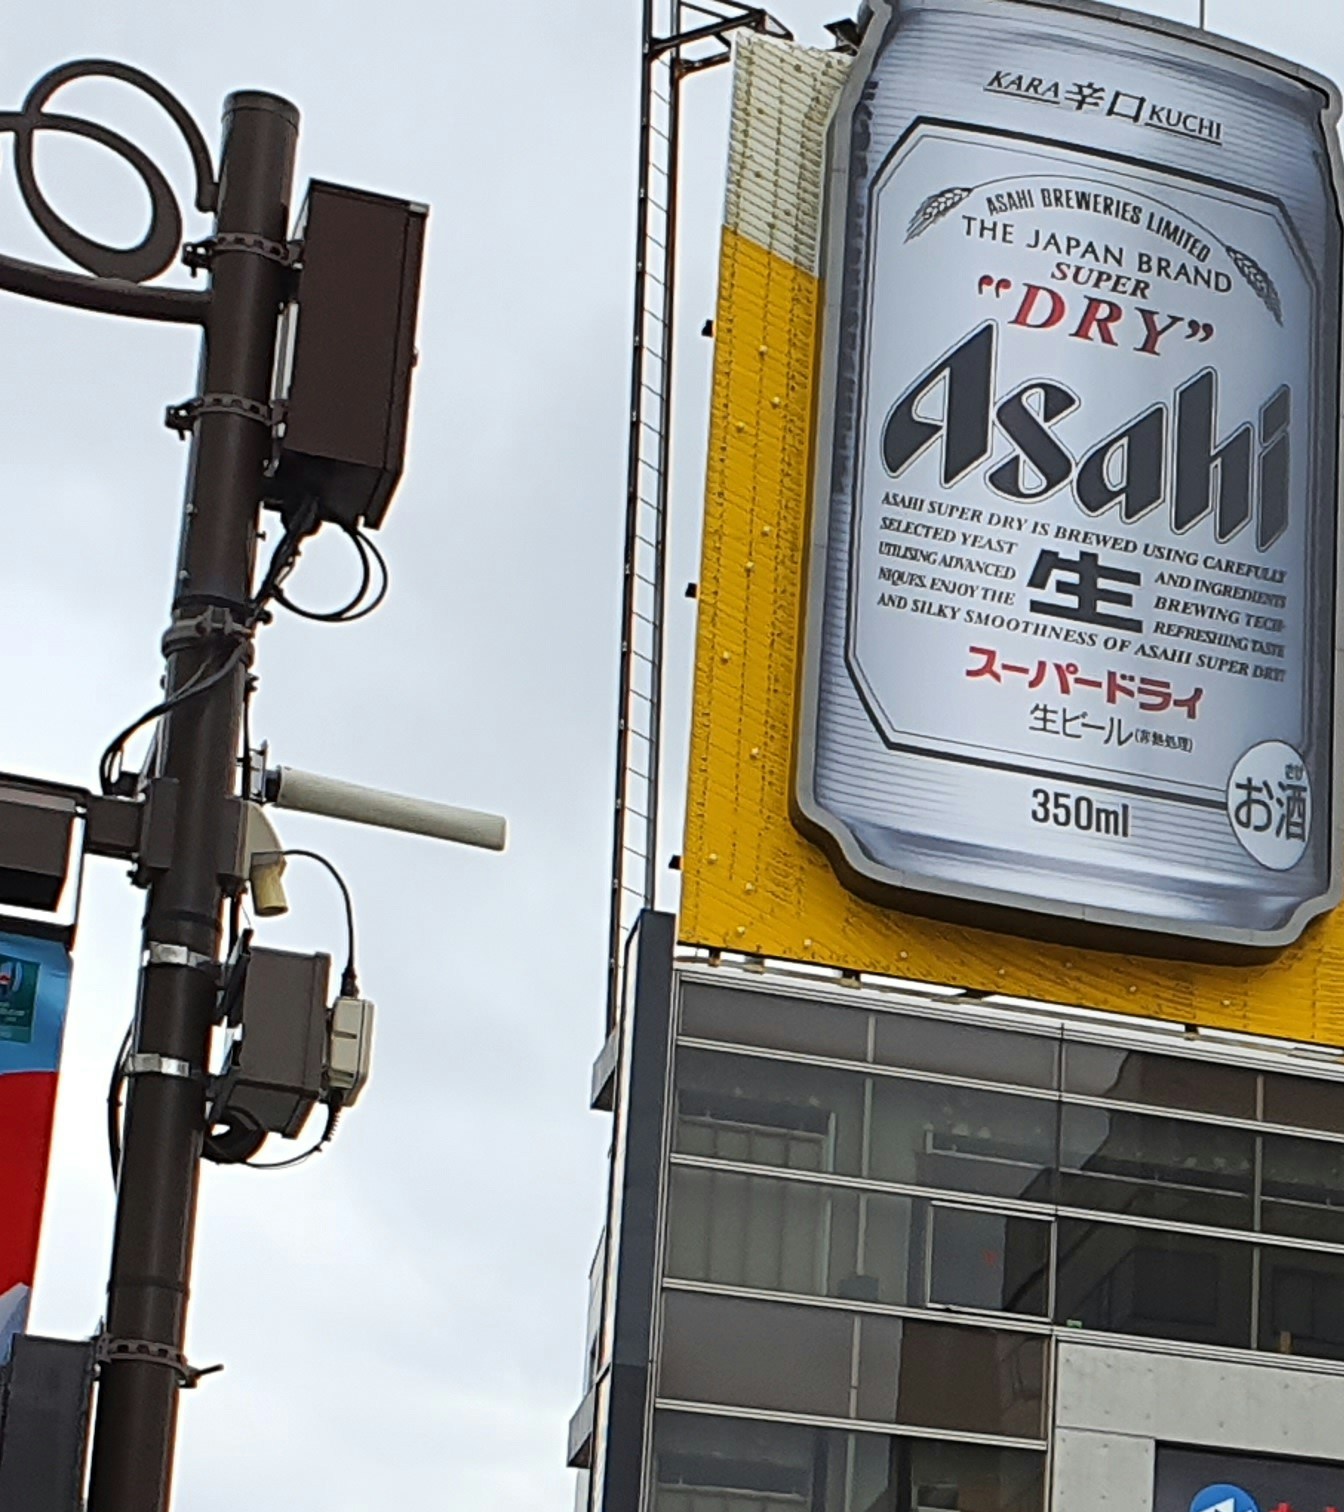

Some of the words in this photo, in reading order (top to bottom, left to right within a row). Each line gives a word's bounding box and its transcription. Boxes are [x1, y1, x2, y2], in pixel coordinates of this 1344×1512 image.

[987, 69, 1061, 101] KARA
[1064, 80, 1146, 123] 辛口
[1149, 104, 1224, 140] KUCHI
[962, 215, 1015, 244] THE
[1026, 229, 1124, 267] JAPAN
[1137, 252, 1233, 294] BRAND
[986, 188, 1035, 216] ASAHI
[1040, 188, 1143, 225] BREWERIES
[1146, 211, 1212, 264] LIMITED
[1051, 262, 1151, 299] SUPER
[881, 319, 1291, 553] Asahi
[880, 516, 957, 543] SELECTED
[961, 532, 1019, 555] YEAST
[881, 491, 925, 512] ASAHI
[927, 500, 983, 524] SUPER
[988, 512, 1028, 532] DRY
[1031, 521, 1051, 536] IS
[1054, 525, 1138, 554] BREWED
[1142, 543, 1199, 566] USING
[1203, 555, 1289, 584] CAREFULLY
[929, 578, 979, 599] ENJOY
[980, 587, 1016, 606] THE
[938, 555, 1017, 581] ADVANCED
[1026, 548, 1143, 634] 生
[1154, 571, 1191, 589] AND
[1193, 579, 1288, 610] INGREDIENTS
[877, 592, 908, 610] AND
[911, 598, 961, 621] SILKY
[964, 609, 1098, 648] SMOOTHNESS
[1103, 636, 1132, 651] OF
[1134, 644, 1193, 665] ASAHI
[1195, 653, 1250, 678] SUPER
[1153, 595, 1240, 625] BREWING
[1153, 620, 1249, 652] REFRESHING
[965, 645, 1204, 720] スーパードライ
[1028, 702, 1134, 747] 生ビール
[1031, 788, 1129, 838] 350ml
[1234, 776, 1308, 843] お酒
